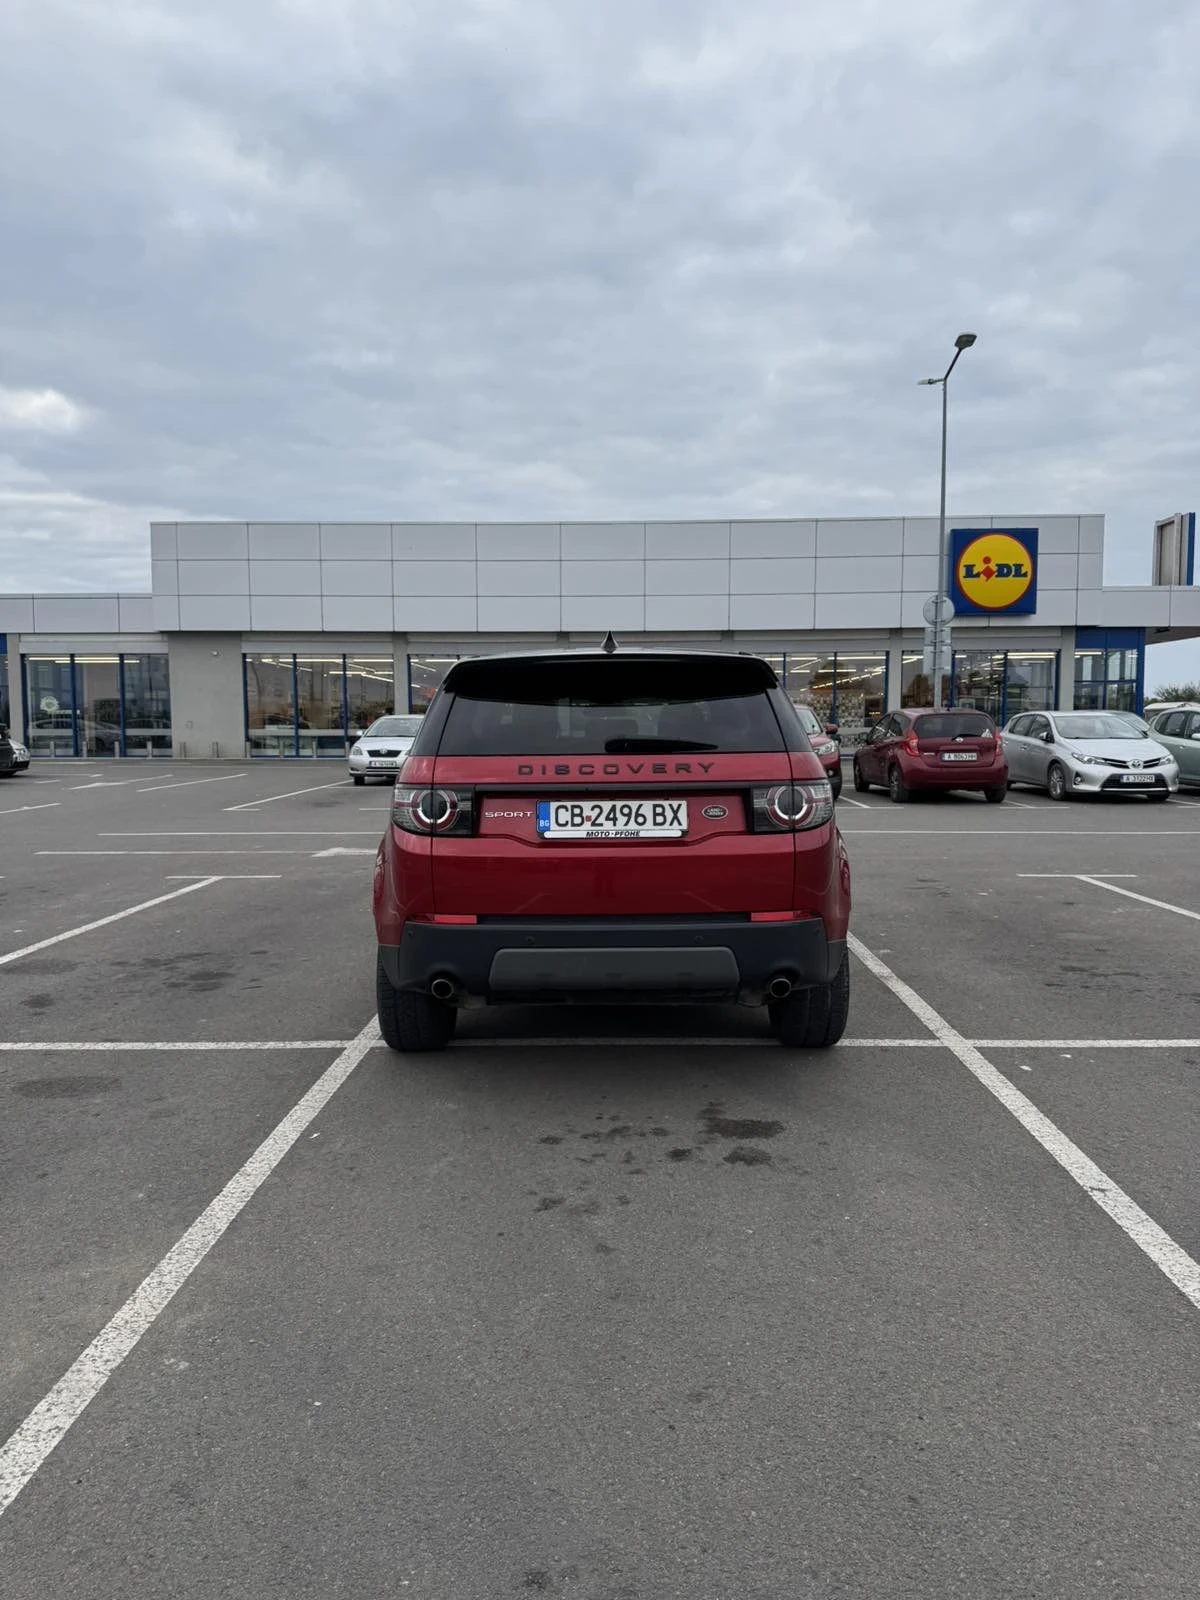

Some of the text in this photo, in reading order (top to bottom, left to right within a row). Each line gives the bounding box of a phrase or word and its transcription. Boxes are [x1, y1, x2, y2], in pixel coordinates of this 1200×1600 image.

[963, 556, 1028, 582] LIDL
[517, 762, 715, 776] DISCOVERY
[539, 819, 550, 828] BG
[554, 803, 683, 828] CB 2496 BX
